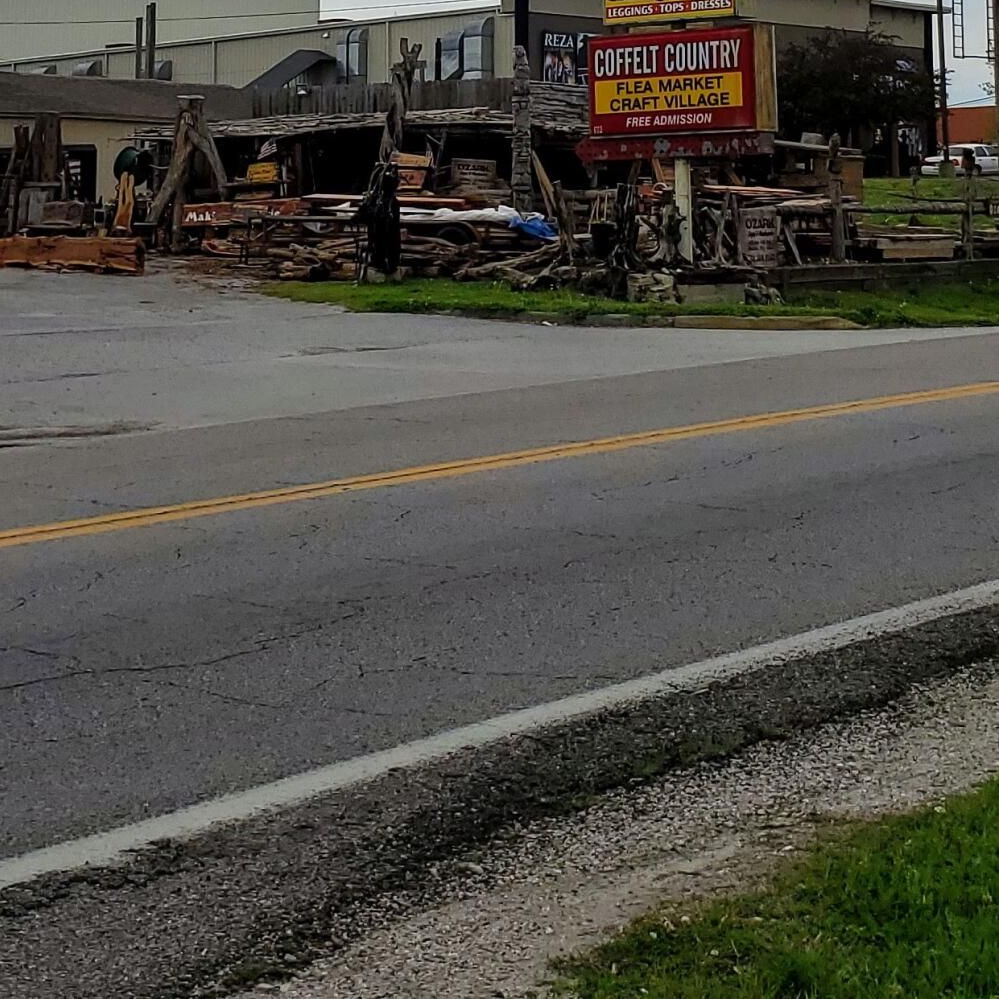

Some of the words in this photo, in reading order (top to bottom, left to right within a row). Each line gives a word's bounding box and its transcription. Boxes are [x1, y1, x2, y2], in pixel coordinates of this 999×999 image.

[608, 6, 654, 18] LEGGINGS
[660, 2, 685, 13] TOPS
[544, 33, 574, 48] REZA
[594, 45, 660, 78] COFFELT
[664, 38, 741, 73] COUNTRY
[616, 80, 653, 95] FLEA
[659, 75, 724, 93] MARKET
[610, 96, 660, 112] CRAFT
[664, 92, 730, 108] VILLAGE
[626, 116, 652, 128] FREE
[653, 113, 712, 126] ADMISSION
